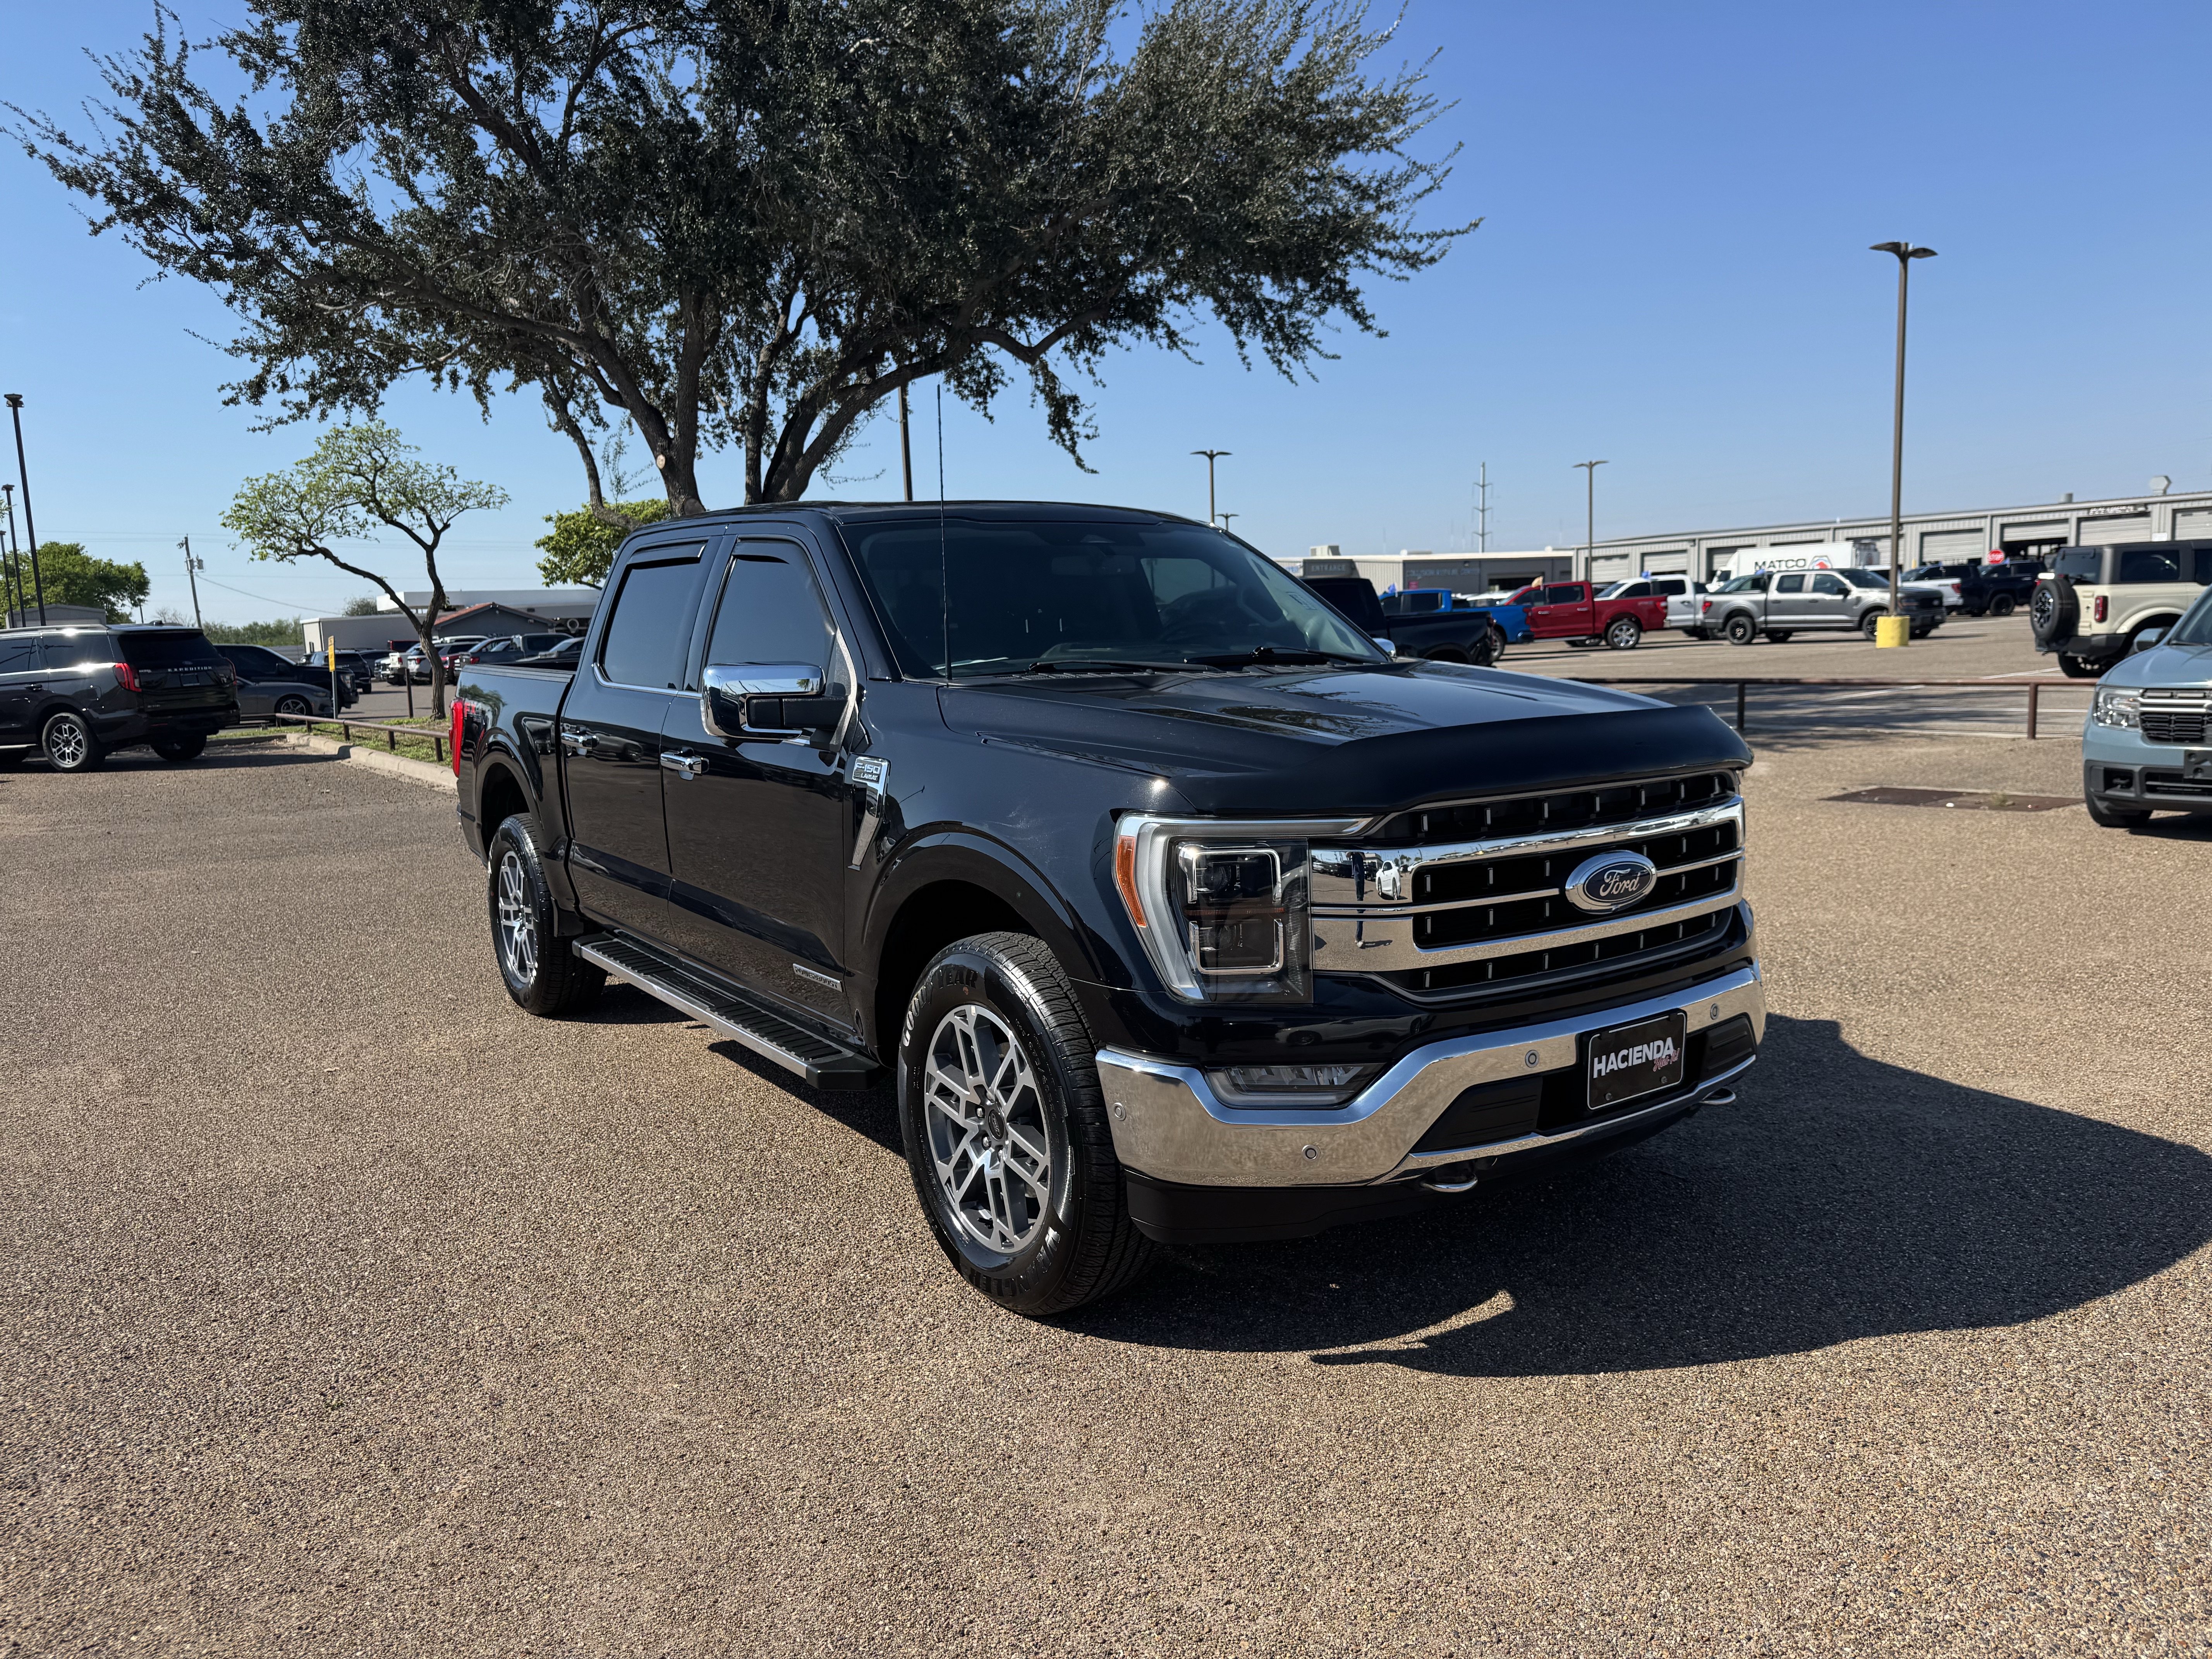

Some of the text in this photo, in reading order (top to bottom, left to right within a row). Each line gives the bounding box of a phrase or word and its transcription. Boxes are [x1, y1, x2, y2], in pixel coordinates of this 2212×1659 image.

[1755, 558, 1806, 570] MATCO
[1600, 868, 1640, 896] Ford
[902, 964, 979, 1047] GOODYEAR
[1593, 1037, 1674, 1078] HACIENDA
[969, 1226, 1061, 1297] WRANGLER
